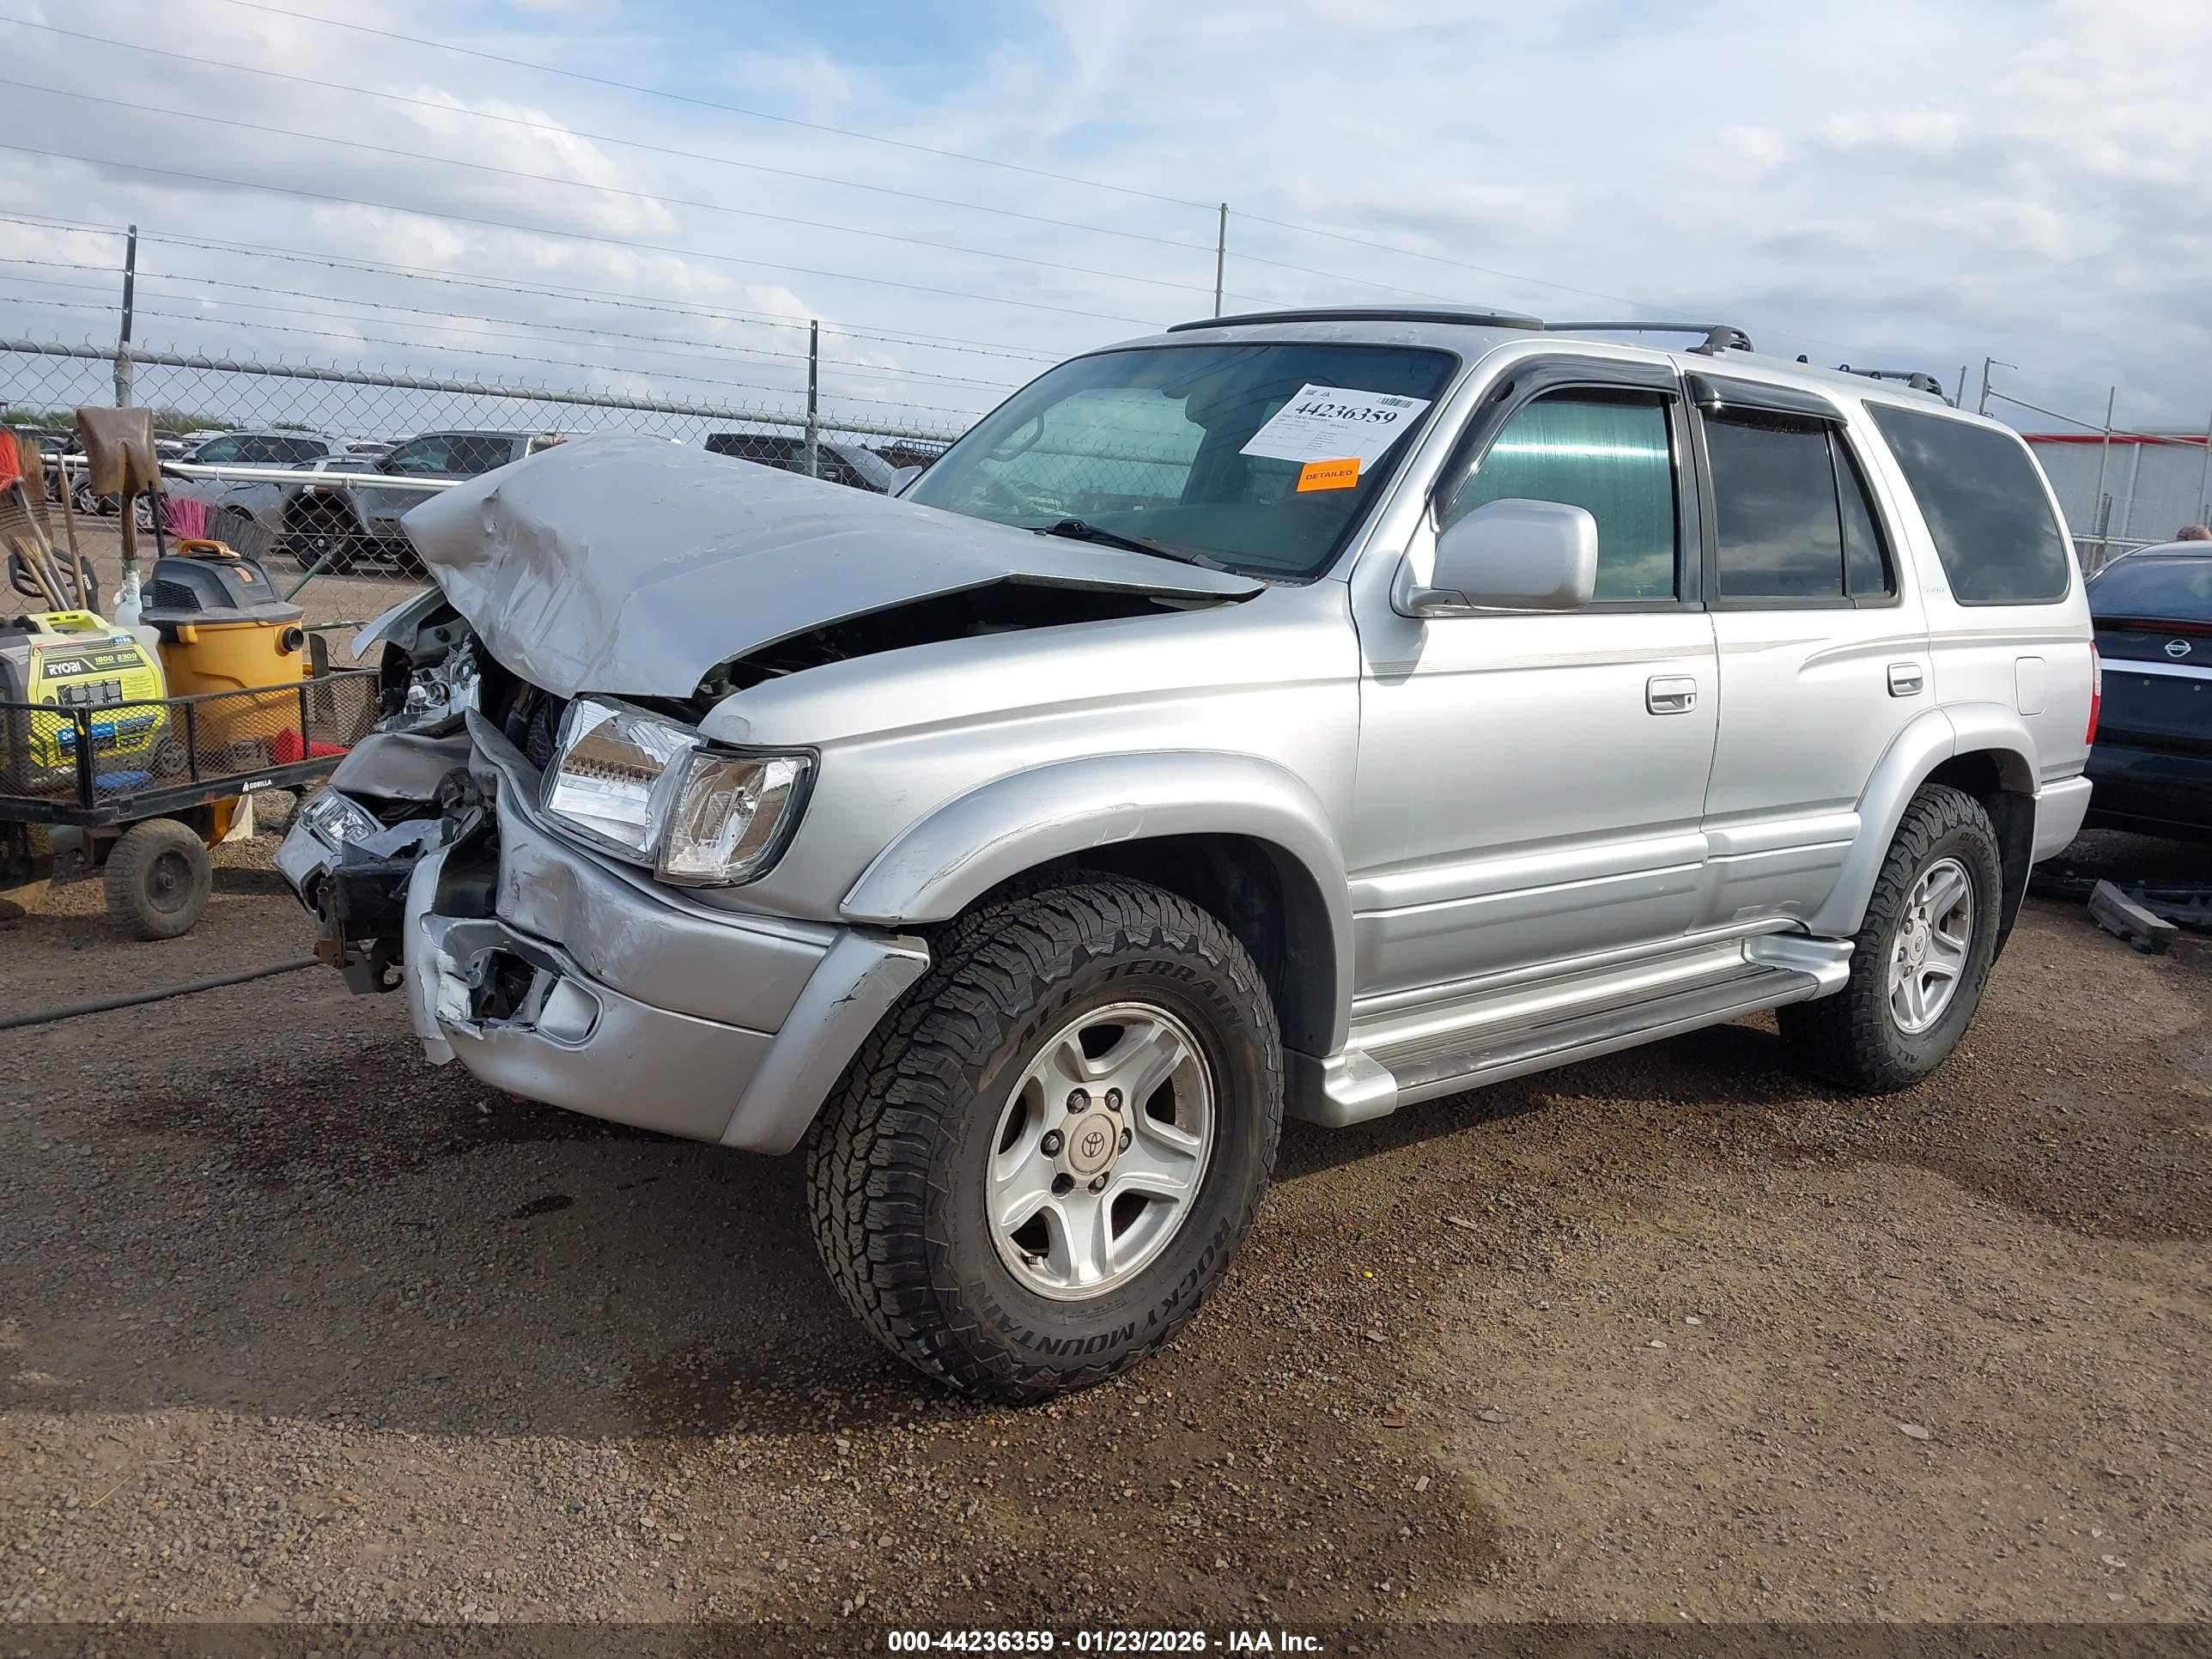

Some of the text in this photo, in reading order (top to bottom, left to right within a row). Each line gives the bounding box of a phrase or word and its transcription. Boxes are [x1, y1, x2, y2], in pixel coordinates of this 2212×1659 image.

[1295, 401, 1398, 425] 44236359
[1305, 470, 1353, 480] DETAILED
[46, 661, 82, 676] RYOBI
[249, 779, 272, 789] GORILLA
[1017, 958, 1244, 1056] ALL TERRAIN
[969, 1217, 1231, 1358] ROCKY MOUNTAIN
